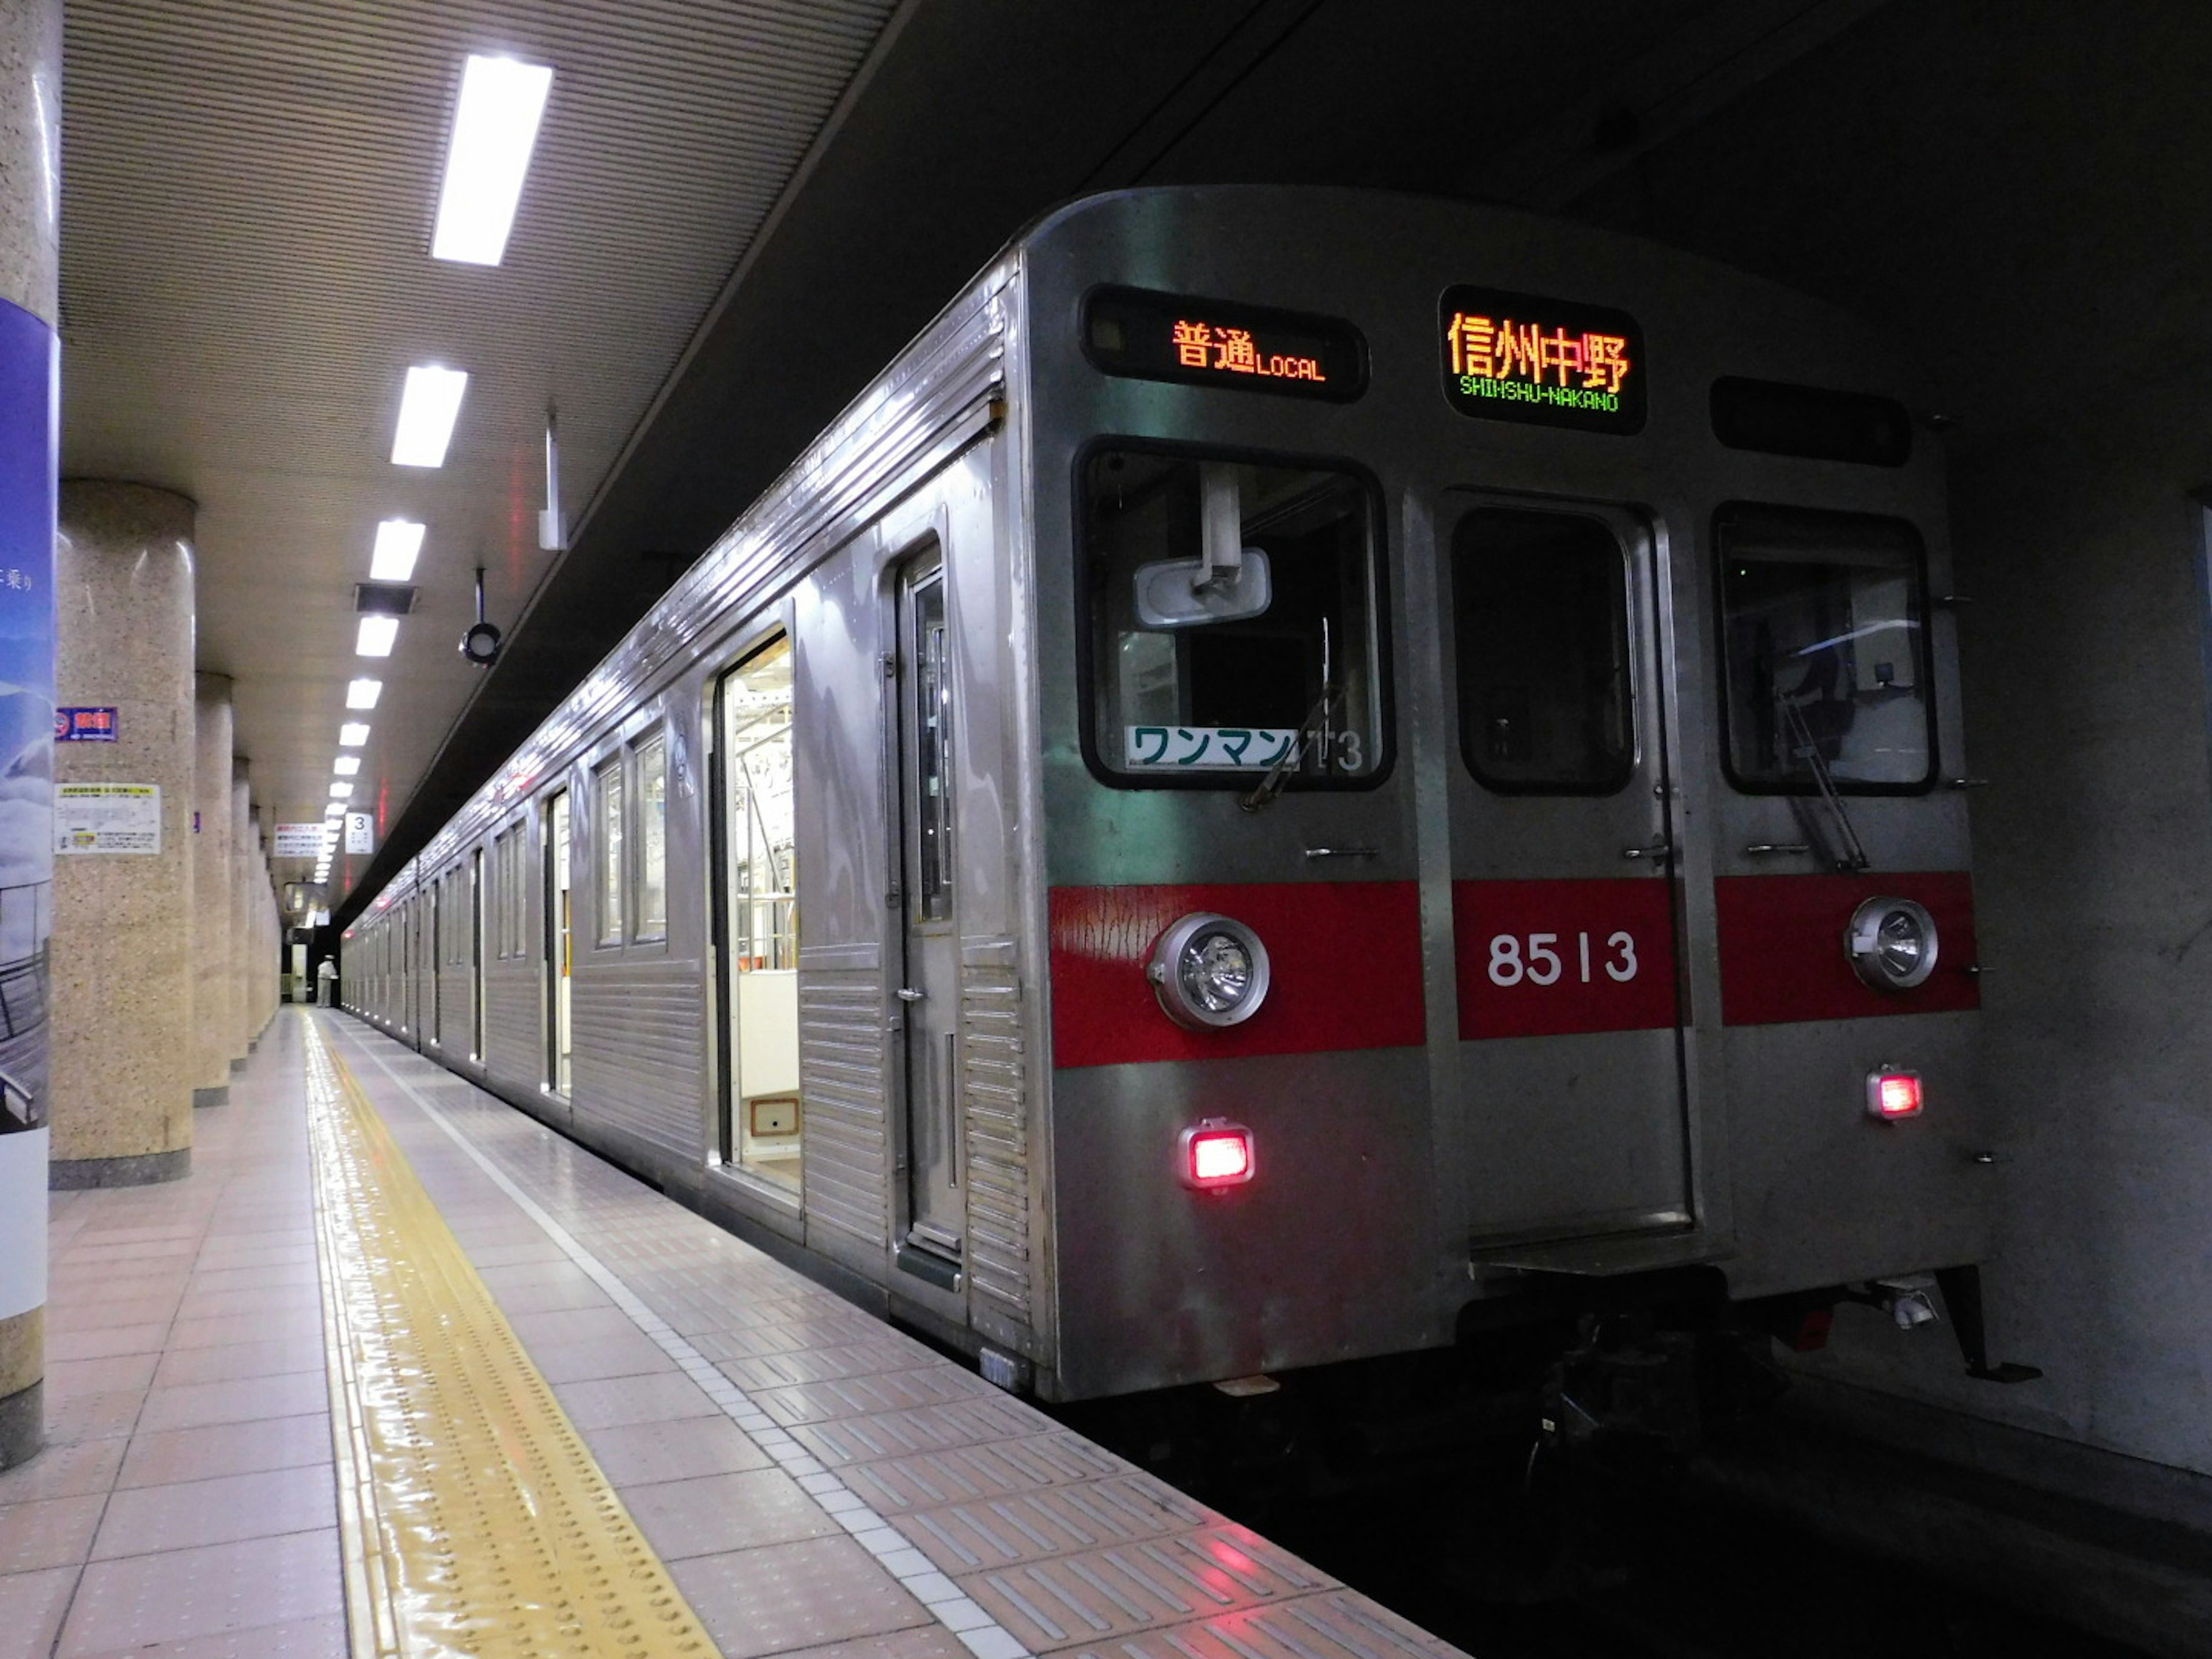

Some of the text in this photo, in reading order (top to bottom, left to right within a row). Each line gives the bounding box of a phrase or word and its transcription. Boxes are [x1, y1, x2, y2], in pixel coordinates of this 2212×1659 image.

[1172, 320, 1326, 382] 普通 LOCAL
[1448, 312, 1628, 393] 信州中野
[1460, 376, 1619, 412] SHINSHU-NAKANO
[1135, 728, 1291, 766] ワンマン
[354, 817, 365, 830] 3
[1488, 931, 1637, 987] 8513
